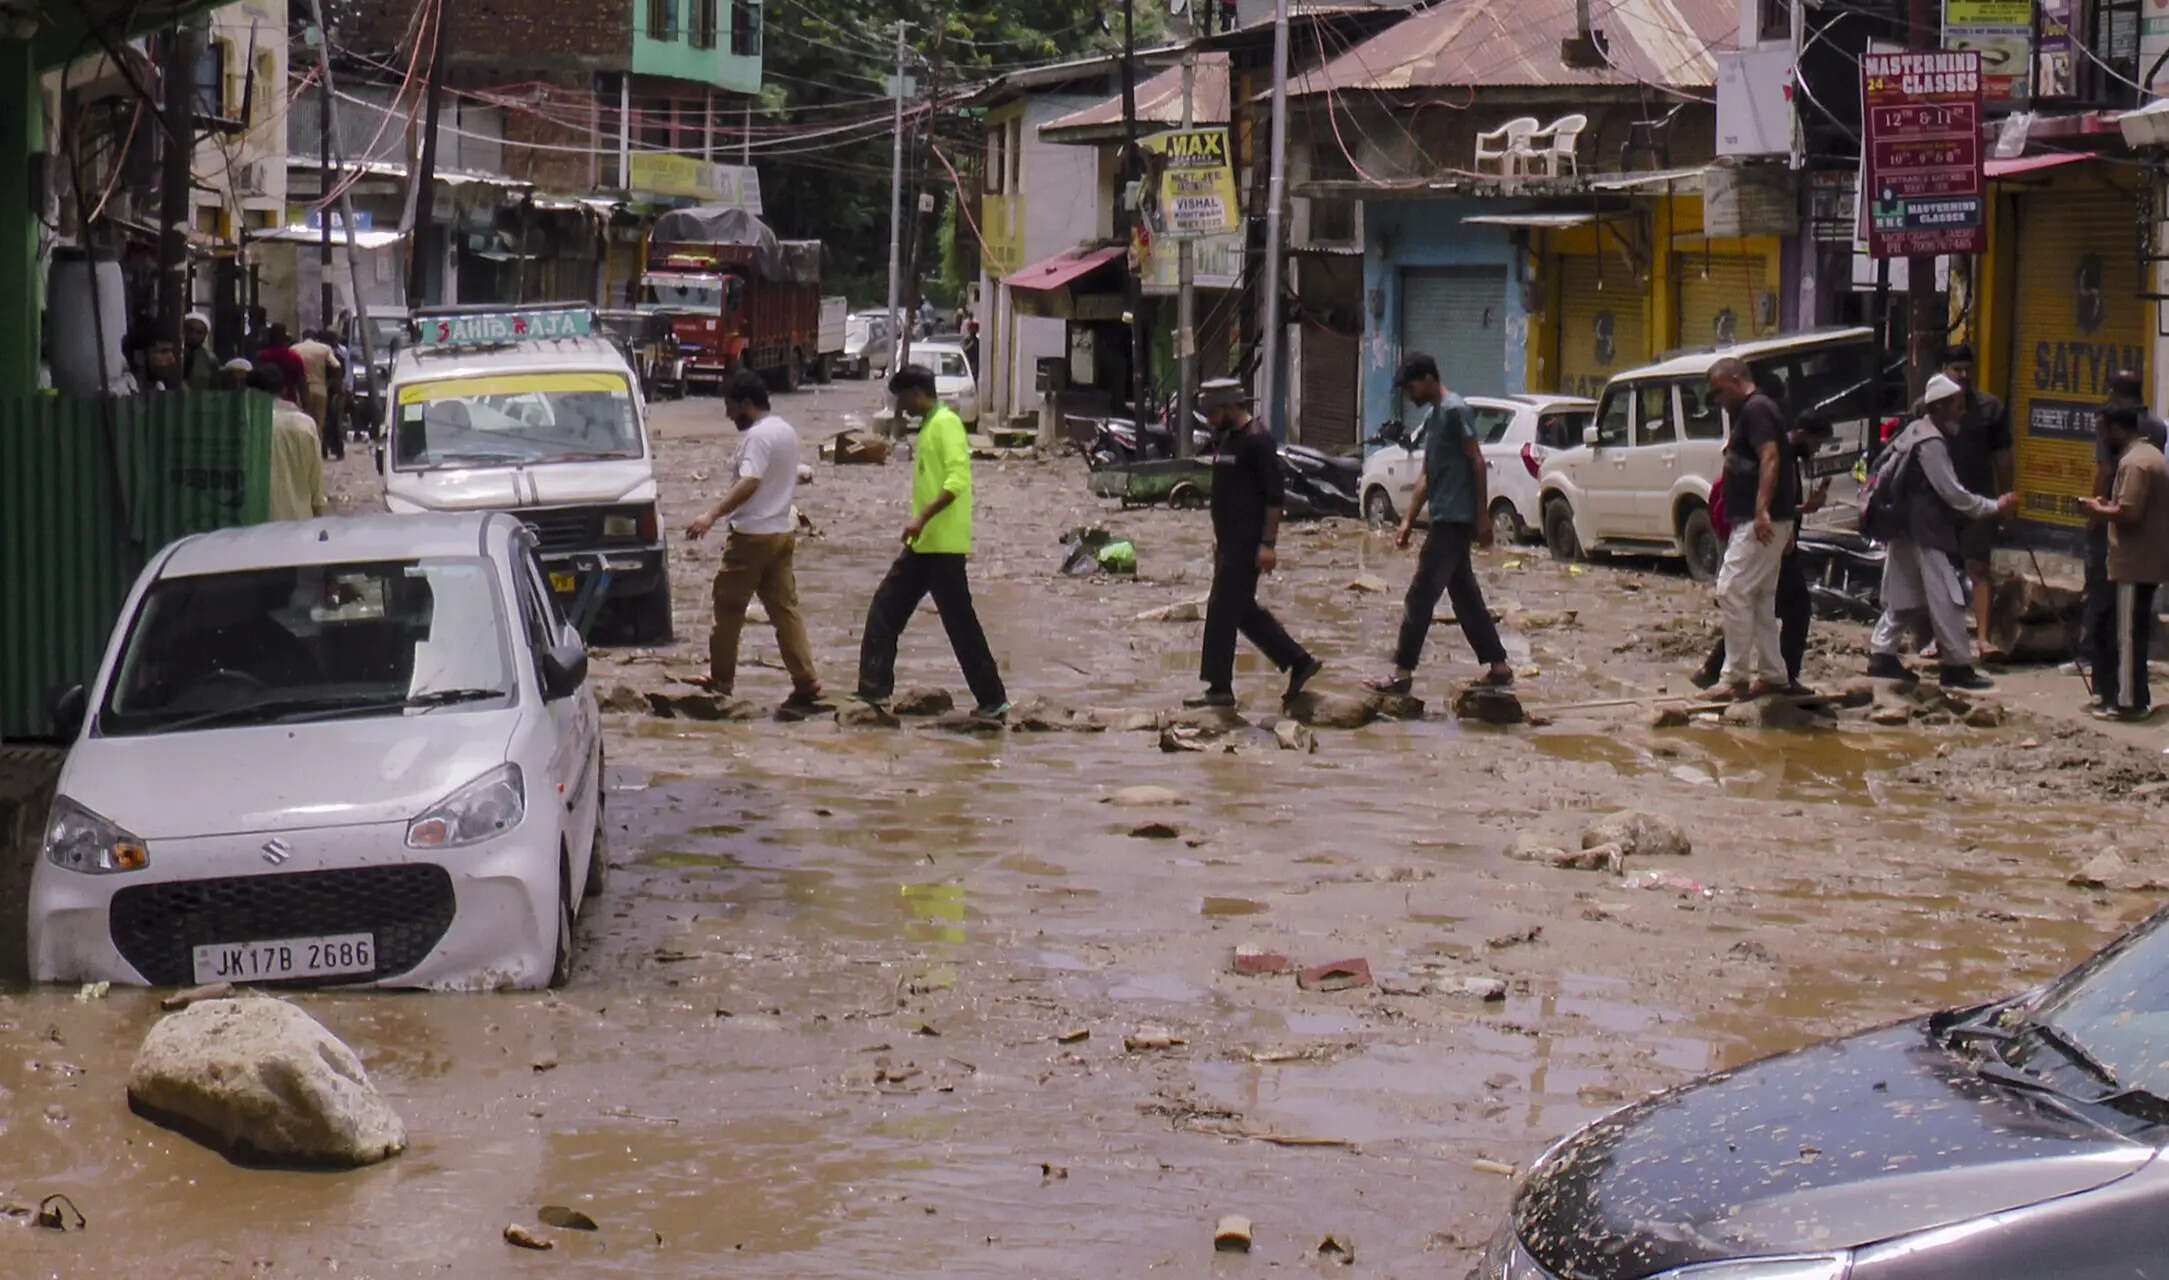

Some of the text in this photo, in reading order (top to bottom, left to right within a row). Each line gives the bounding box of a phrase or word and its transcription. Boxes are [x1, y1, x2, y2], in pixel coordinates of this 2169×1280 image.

[1866, 53, 1977, 76] MASTERMIND
[1868, 78, 1884, 91] 24
[1903, 72, 1978, 94] CLASSES
[1177, 198, 1219, 210] VISHAL
[1907, 201, 1977, 215] MASTERMIND
[217, 941, 369, 976] JK17B 2686
